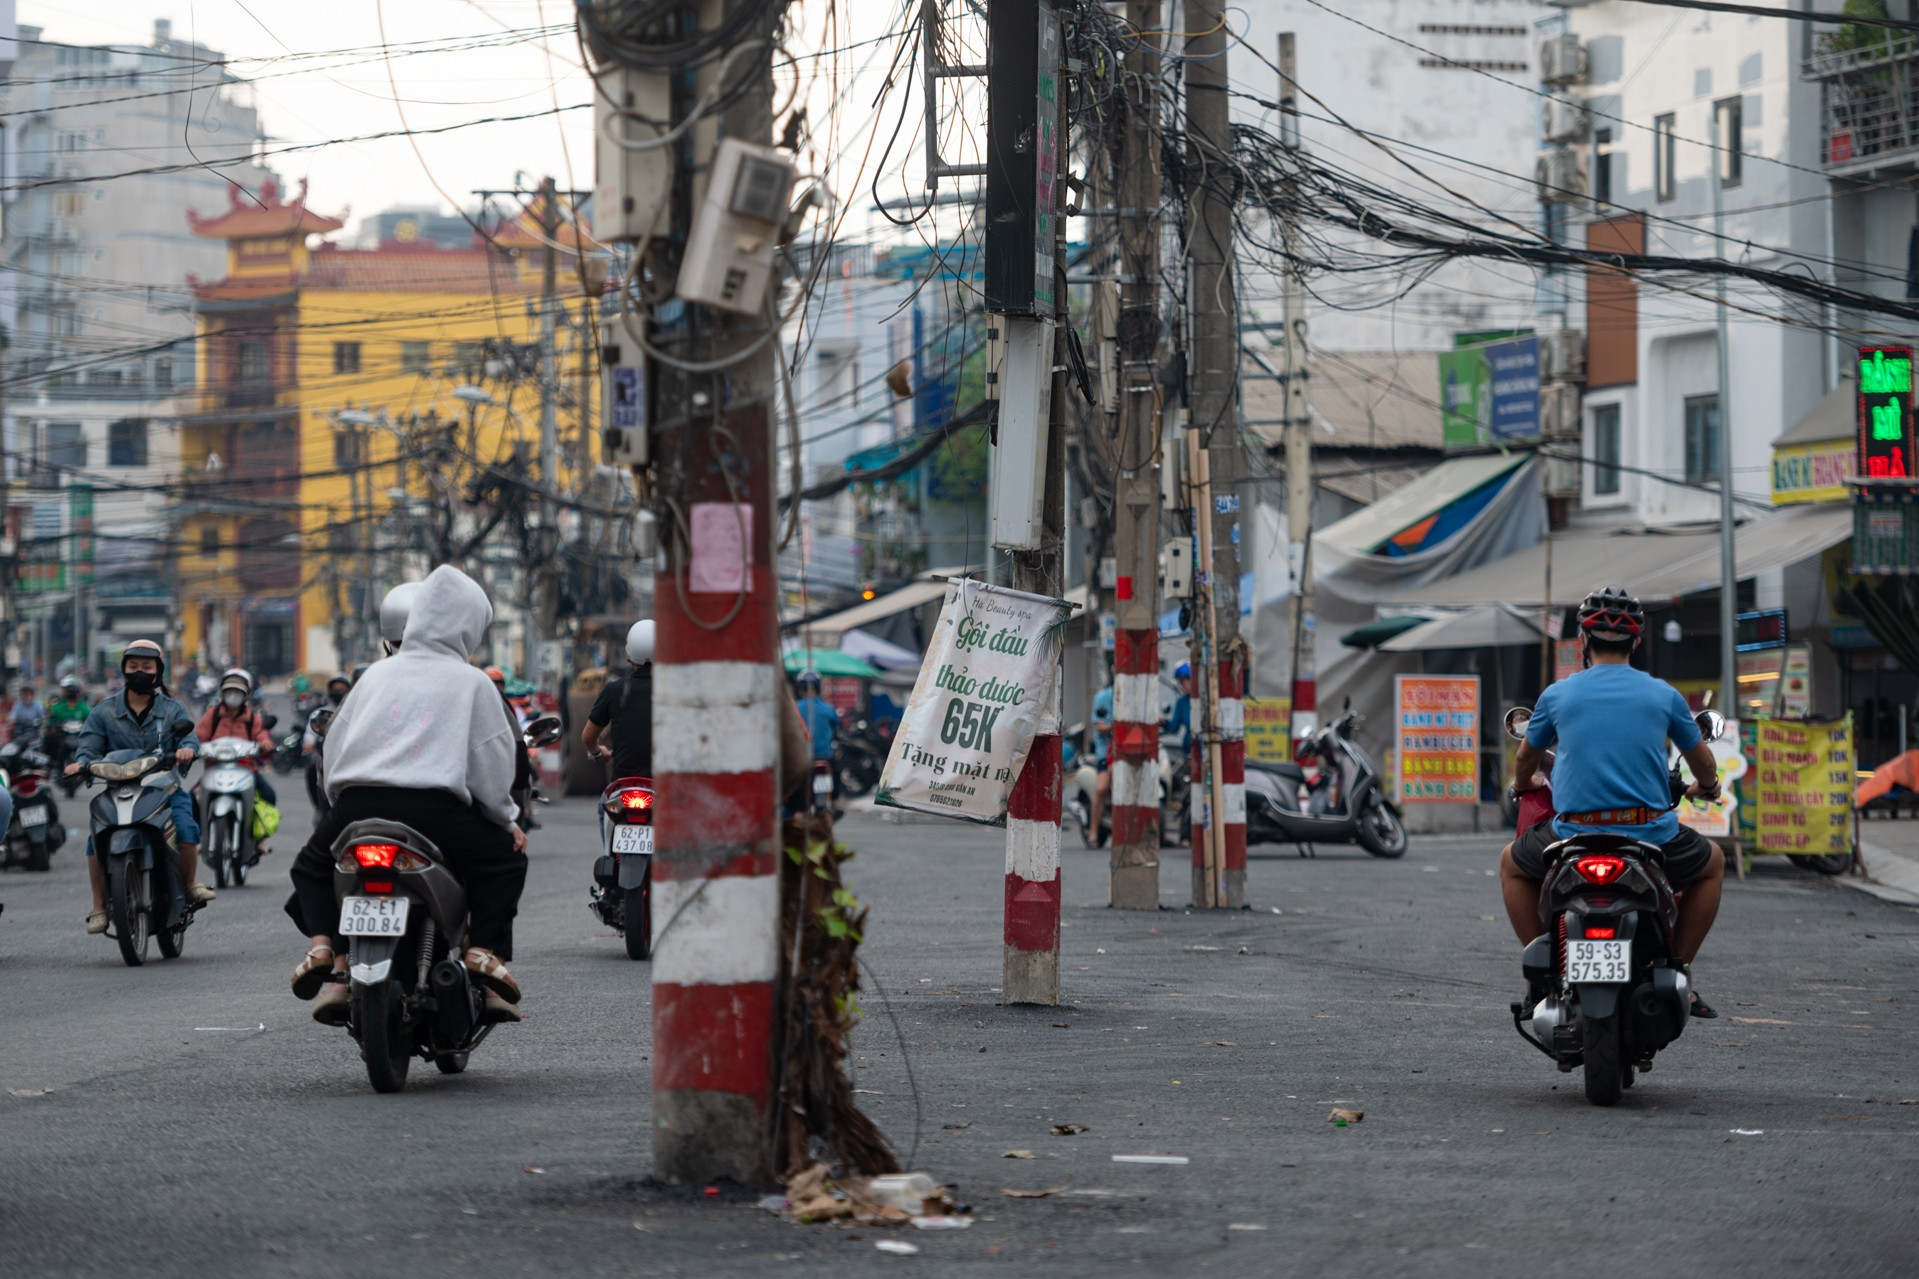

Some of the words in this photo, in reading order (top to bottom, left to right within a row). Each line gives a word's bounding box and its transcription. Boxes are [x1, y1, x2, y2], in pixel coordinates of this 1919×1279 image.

[985, 599, 1015, 619] Beauty
[1017, 609, 1032, 622] spa
[956, 615, 988, 653] Gội
[989, 627, 1029, 657] đầu
[935, 664, 979, 697] thảo
[978, 676, 1025, 711] dược
[940, 697, 1002, 753] 65K
[1403, 708, 1432, 727] BÁNH
[1827, 728, 1847, 743] 10K
[901, 742, 948, 775] Tặng
[952, 761, 990, 780] mặt
[1403, 754, 1442, 774] BÁNH
[1445, 757, 1475, 774] BAO
[1827, 750, 1848, 764] 10K
[1828, 770, 1849, 785] 15K
[1403, 777, 1444, 797] BÁNH
[1829, 791, 1849, 806] 20K
[1762, 812, 1788, 827] SINH
[620, 827, 650, 839] 62-P1
[615, 839, 653, 852] 437.08
[352, 900, 397, 916] 62-E1
[344, 917, 401, 933] 300.84
[1576, 942, 1621, 960] 59-S3
[1571, 962, 1626, 980] 575.35
